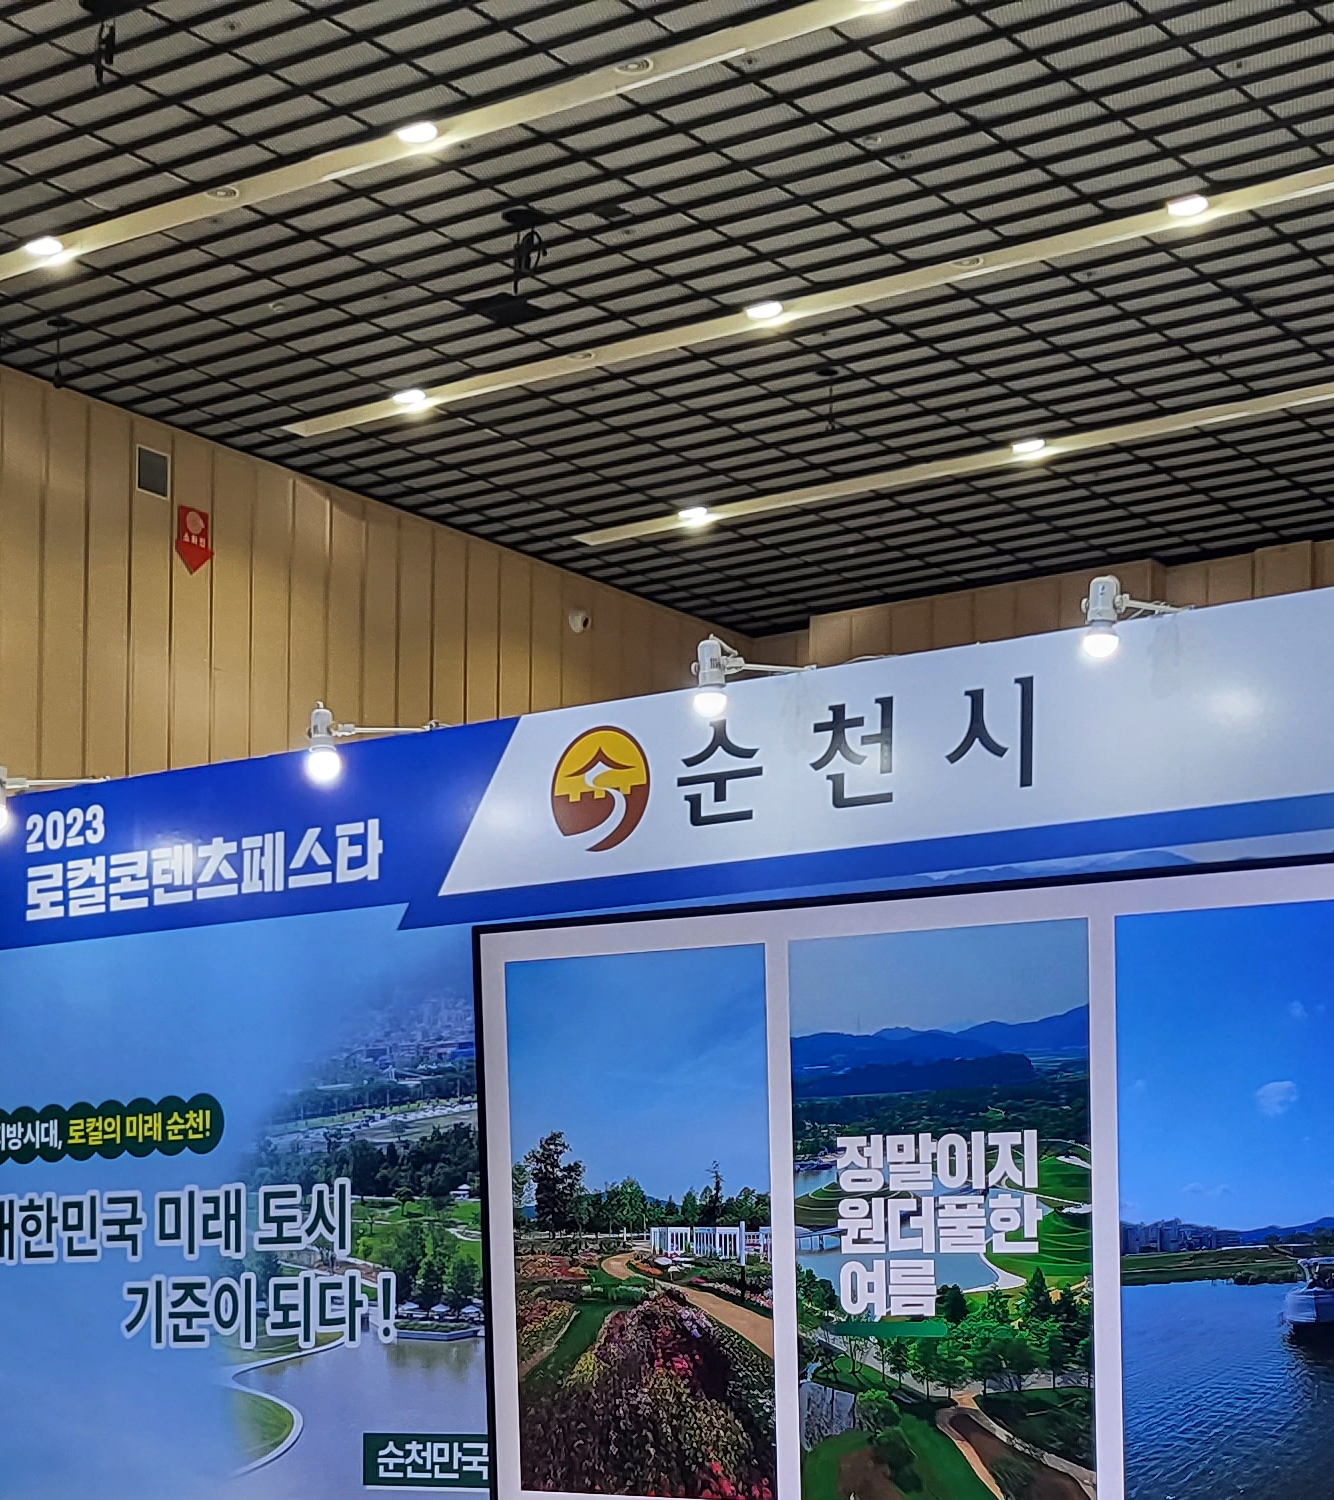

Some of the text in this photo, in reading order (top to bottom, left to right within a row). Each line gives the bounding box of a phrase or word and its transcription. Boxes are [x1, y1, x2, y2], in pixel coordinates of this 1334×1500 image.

[677, 675, 1035, 827] 순천시
[26, 804, 104, 853] 2023
[26, 819, 384, 922] 로컬콘텐츠페스타
[67, 1116, 121, 1147] 로컬의
[125, 1113, 162, 1144] 미래
[165, 1110, 212, 1141] 순천!
[836, 1130, 1038, 1192] 정말이지
[157, 1184, 243, 1258] 미래
[257, 1177, 352, 1255] 도시
[837, 1194, 1043, 1254] 원더풀한
[123, 1273, 257, 1348] 기준이
[839, 1259, 937, 1317] 여름
